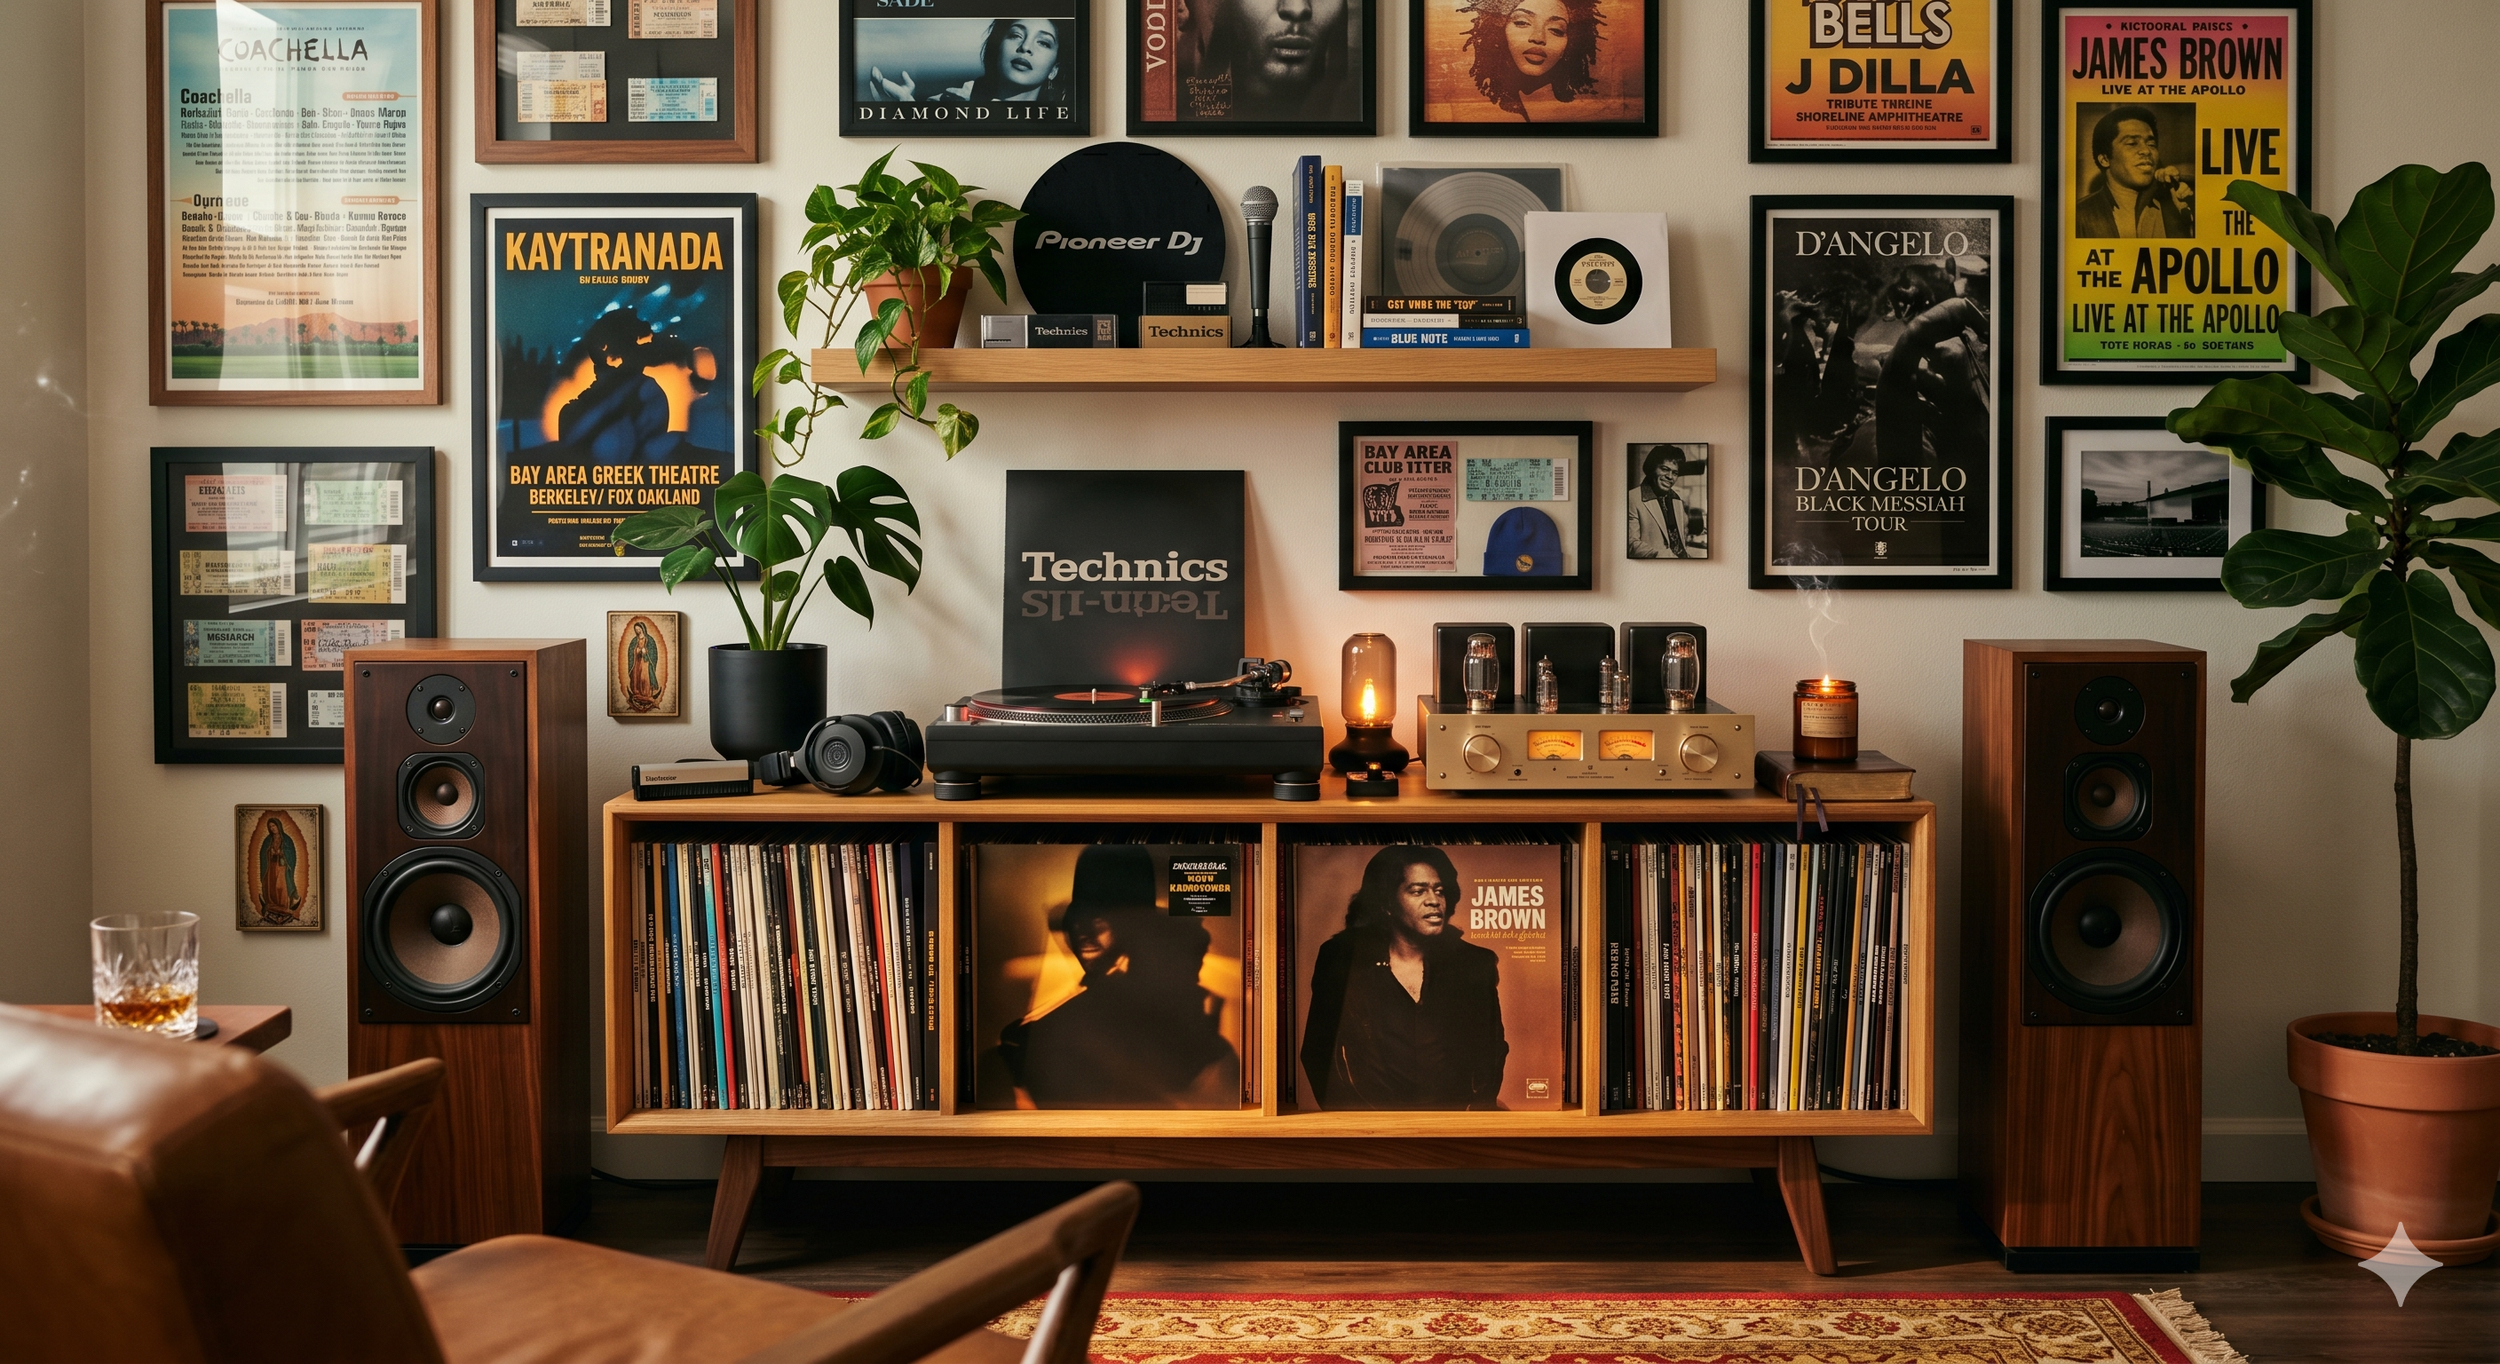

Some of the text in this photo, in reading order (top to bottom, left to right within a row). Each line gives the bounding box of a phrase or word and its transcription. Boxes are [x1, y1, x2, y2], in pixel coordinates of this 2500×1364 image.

[1811, 1, 1952, 48] BELLS
[217, 38, 368, 62] COACHELLA
[2072, 37, 2282, 80] JAMES BROWN
[1785, 58, 1975, 95] J DILLA
[180, 88, 252, 104] Coachella
[2102, 85, 2246, 95] LIVE AT THE APOLLO
[1826, 99, 1878, 109] TRIBUTE
[859, 106, 1070, 121] DIAMOND LIFE
[1796, 112, 1964, 123] SHORELINE AMPHITHEATRE
[2202, 128, 2281, 175] LIVE
[2223, 210, 2256, 236] THE
[1034, 231, 1161, 250] Pioneer
[1795, 231, 1969, 257] D'ANGELO
[506, 232, 724, 271] KAYTRANADA
[2085, 249, 2115, 266] AT
[2077, 247, 2280, 295] THE APOLLO
[1435, 300, 1452, 310] THE
[2072, 303, 2280, 334] LIVE AT THE APOLLO
[1034, 326, 1089, 336] Technics
[1148, 325, 1224, 338] Technics
[1391, 333, 1418, 344] BLUE
[1421, 333, 1448, 344] NOTE
[2100, 341, 2129, 350] TOTE
[2133, 341, 2173, 350] HORAS
[1365, 445, 1453, 460] BAY AREA
[510, 465, 720, 485] BAY AREA GREEK THEATRE
[1364, 461, 1404, 474] CLUB
[1795, 466, 1967, 493] D'ANGELO
[529, 488, 701, 505] BERKELEY/ FOX OAKLAND
[1796, 496, 1966, 512] BLACK MESSIAH
[1852, 516, 1909, 532] TOUR
[1021, 551, 1228, 582] Technics
[1471, 885, 1545, 907] JAMES
[1470, 908, 1546, 930] BROWN
